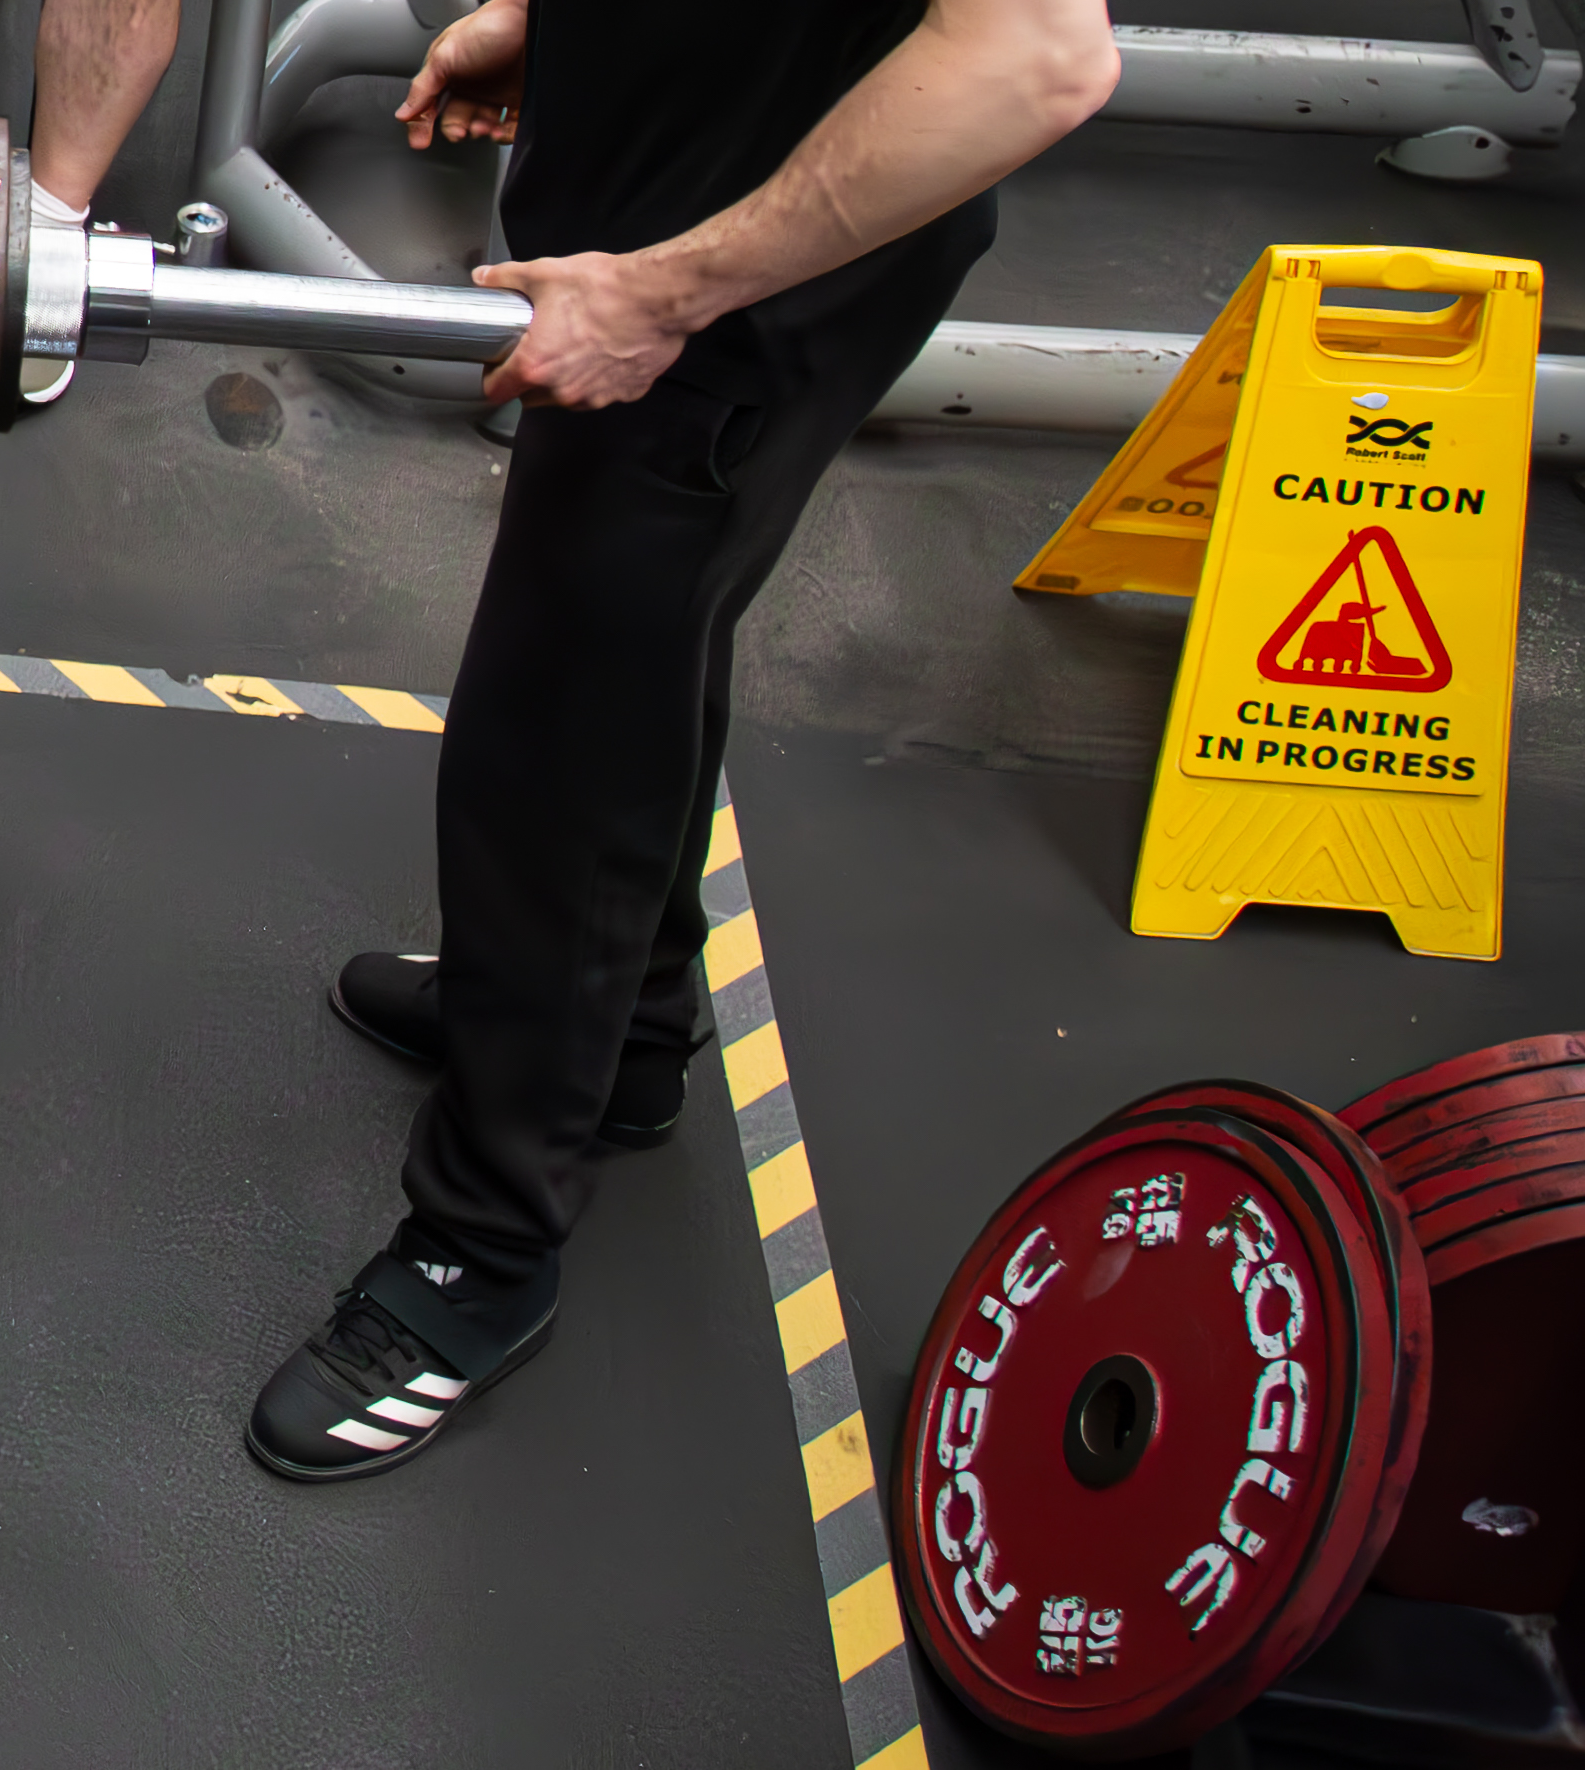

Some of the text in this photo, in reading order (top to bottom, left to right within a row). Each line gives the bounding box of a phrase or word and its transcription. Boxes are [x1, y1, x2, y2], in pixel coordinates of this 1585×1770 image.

[1345, 446, 1427, 462] Robert Scott
[1273, 473, 1486, 515] CAUTION
[1237, 700, 1451, 741] CLEANING
[1195, 734, 1477, 781] IN PROGRESS
[934, 1225, 1068, 1639] ROGUE
[1165, 1193, 1308, 1633] ROGUE
